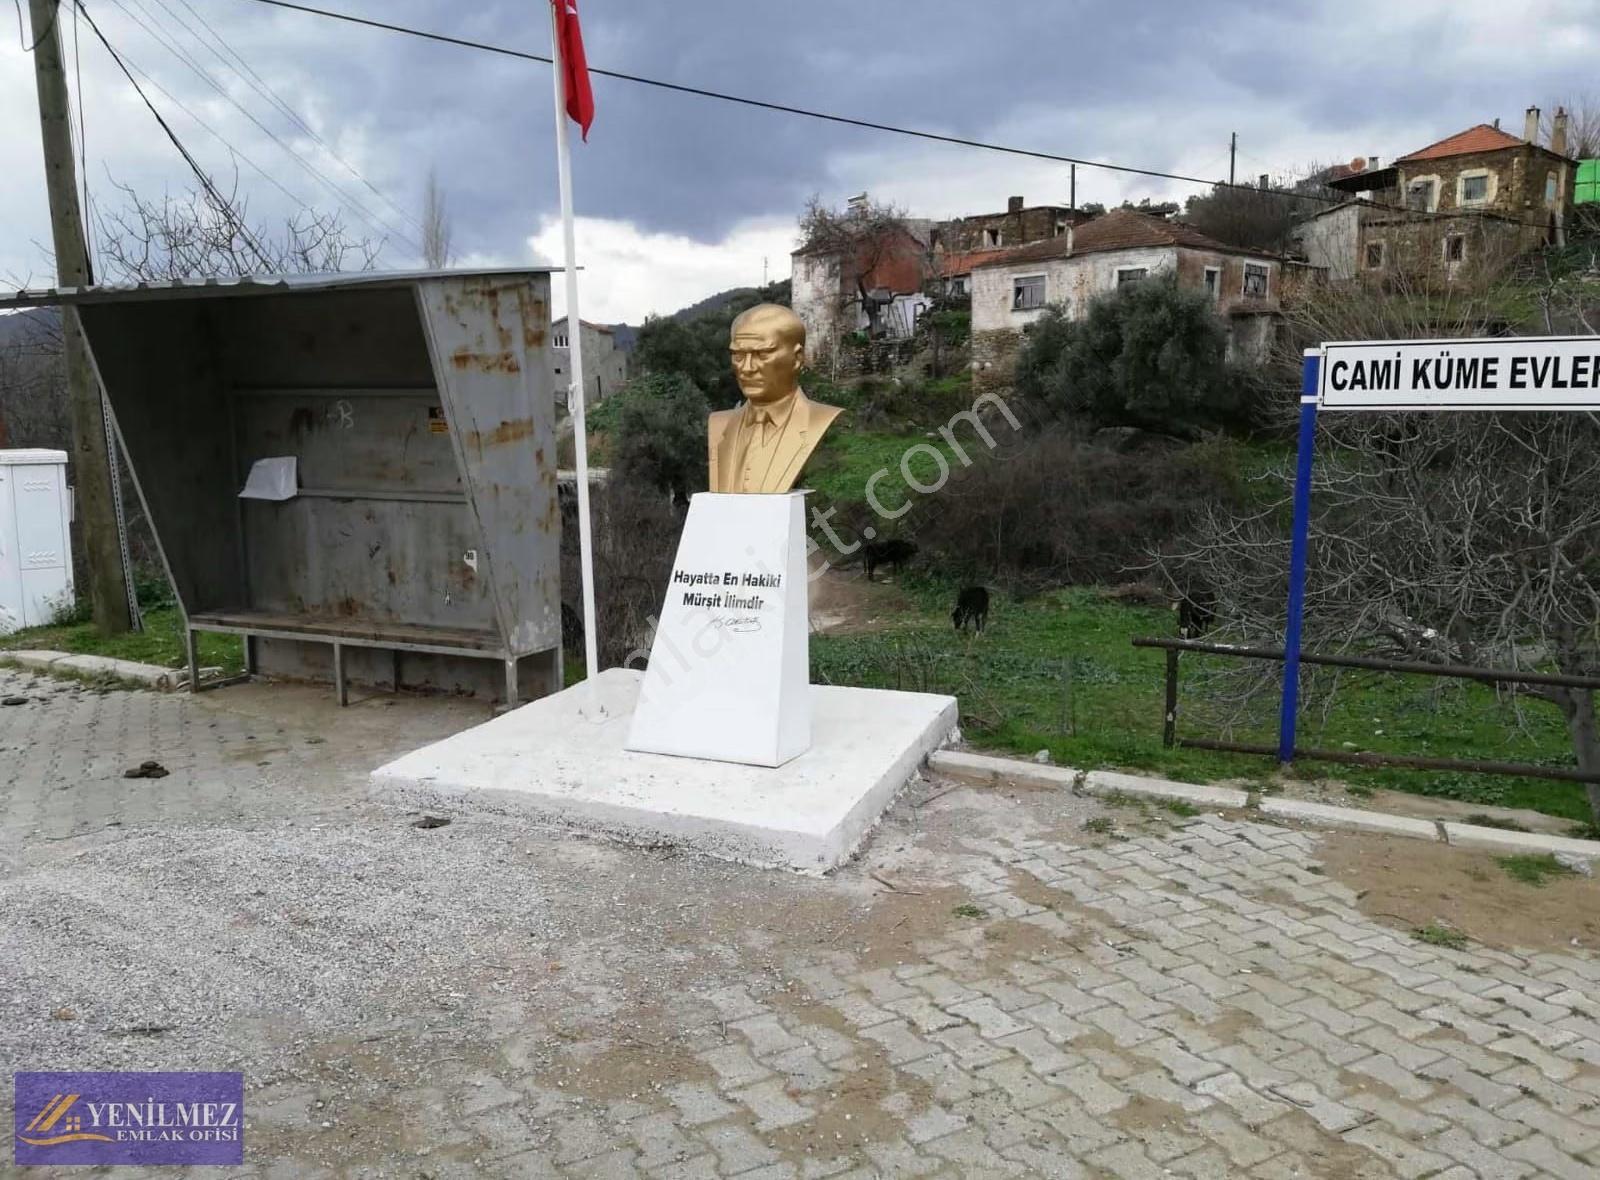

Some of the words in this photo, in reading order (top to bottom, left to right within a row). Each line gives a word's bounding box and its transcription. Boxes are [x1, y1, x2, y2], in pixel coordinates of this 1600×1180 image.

[1330, 351, 1401, 391] CAMİ
[1411, 350, 1499, 390] KÜME
[674, 570, 720, 587] Hayatta
[723, 572, 738, 586] En
[742, 573, 782, 588] Hakiki
[682, 592, 722, 610] Mürşit
[724, 591, 764, 610] İlimdir
